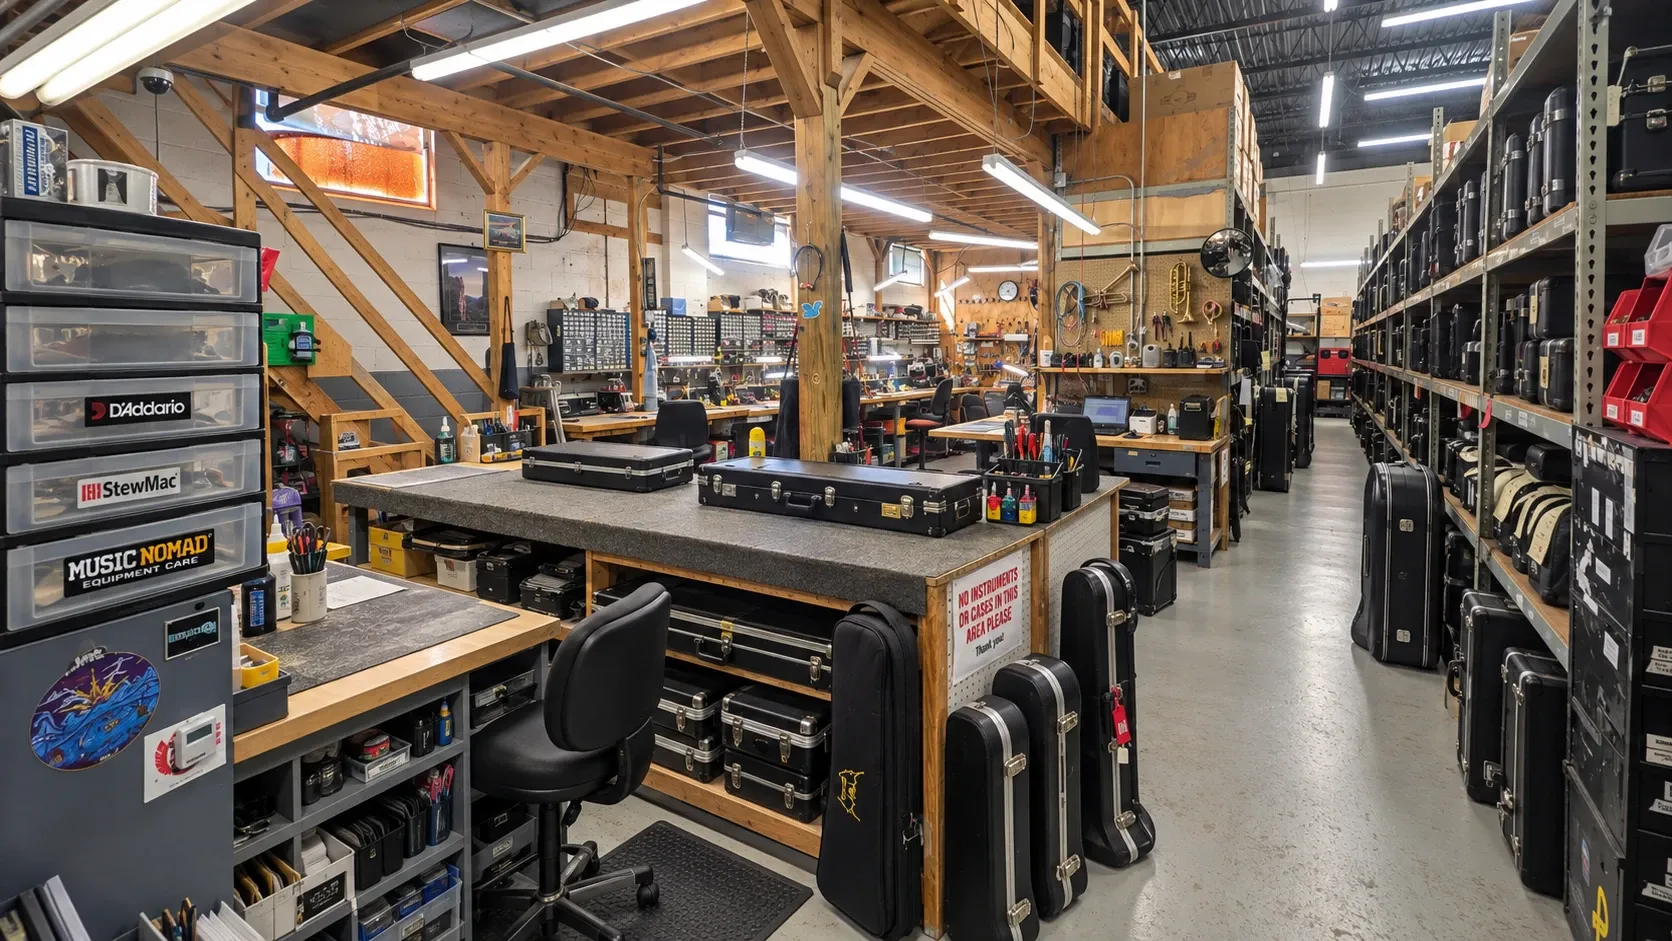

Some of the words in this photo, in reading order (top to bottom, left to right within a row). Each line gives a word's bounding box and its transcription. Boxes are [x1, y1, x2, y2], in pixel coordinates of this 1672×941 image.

[109, 399, 185, 418] D'Addario
[103, 475, 176, 498] StewMac
[68, 550, 137, 582] MUSIC
[140, 535, 209, 567] NOMAD
[82, 565, 161, 589] EQUIPMENT
[165, 557, 199, 571] CARE
[958, 590, 969, 609] NO
[970, 567, 1018, 602] INSTRUMENTS
[958, 610, 969, 628] OR
[970, 597, 993, 622] CASES
[994, 592, 1002, 609] IN
[1003, 584, 1018, 604] THIS
[966, 621, 986, 644] AREA
[987, 606, 1012, 632] PLEASE
[975, 639, 992, 657] Thank
[992, 632, 1005, 649] you!
